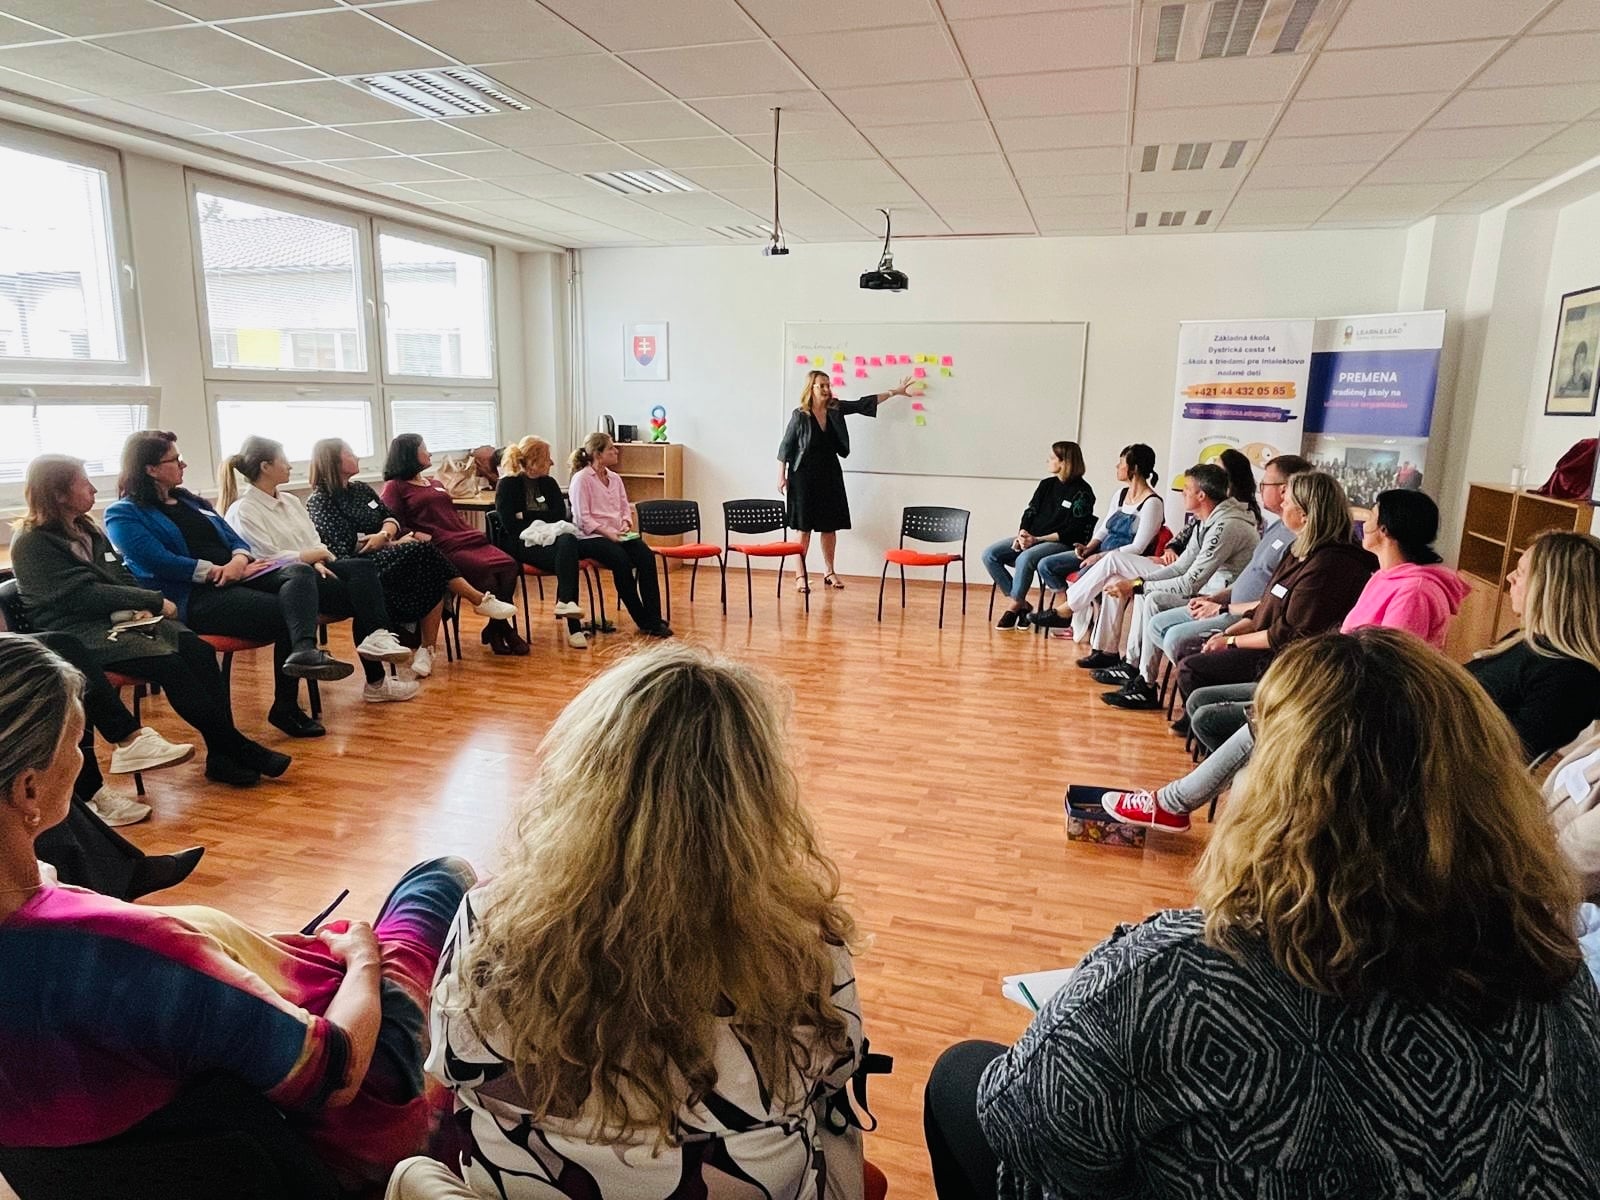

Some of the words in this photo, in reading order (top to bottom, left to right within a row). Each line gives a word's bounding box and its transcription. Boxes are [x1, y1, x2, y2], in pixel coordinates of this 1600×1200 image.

[1338, 371, 1398, 383] PREMENA
[1195, 387, 1217, 396] +421
[1220, 388, 1232, 396] 44
[1236, 387, 1254, 396] 432
[1257, 387, 1270, 396] 05
[1272, 386, 1286, 395] 85
[1368, 387, 1391, 398] školy
